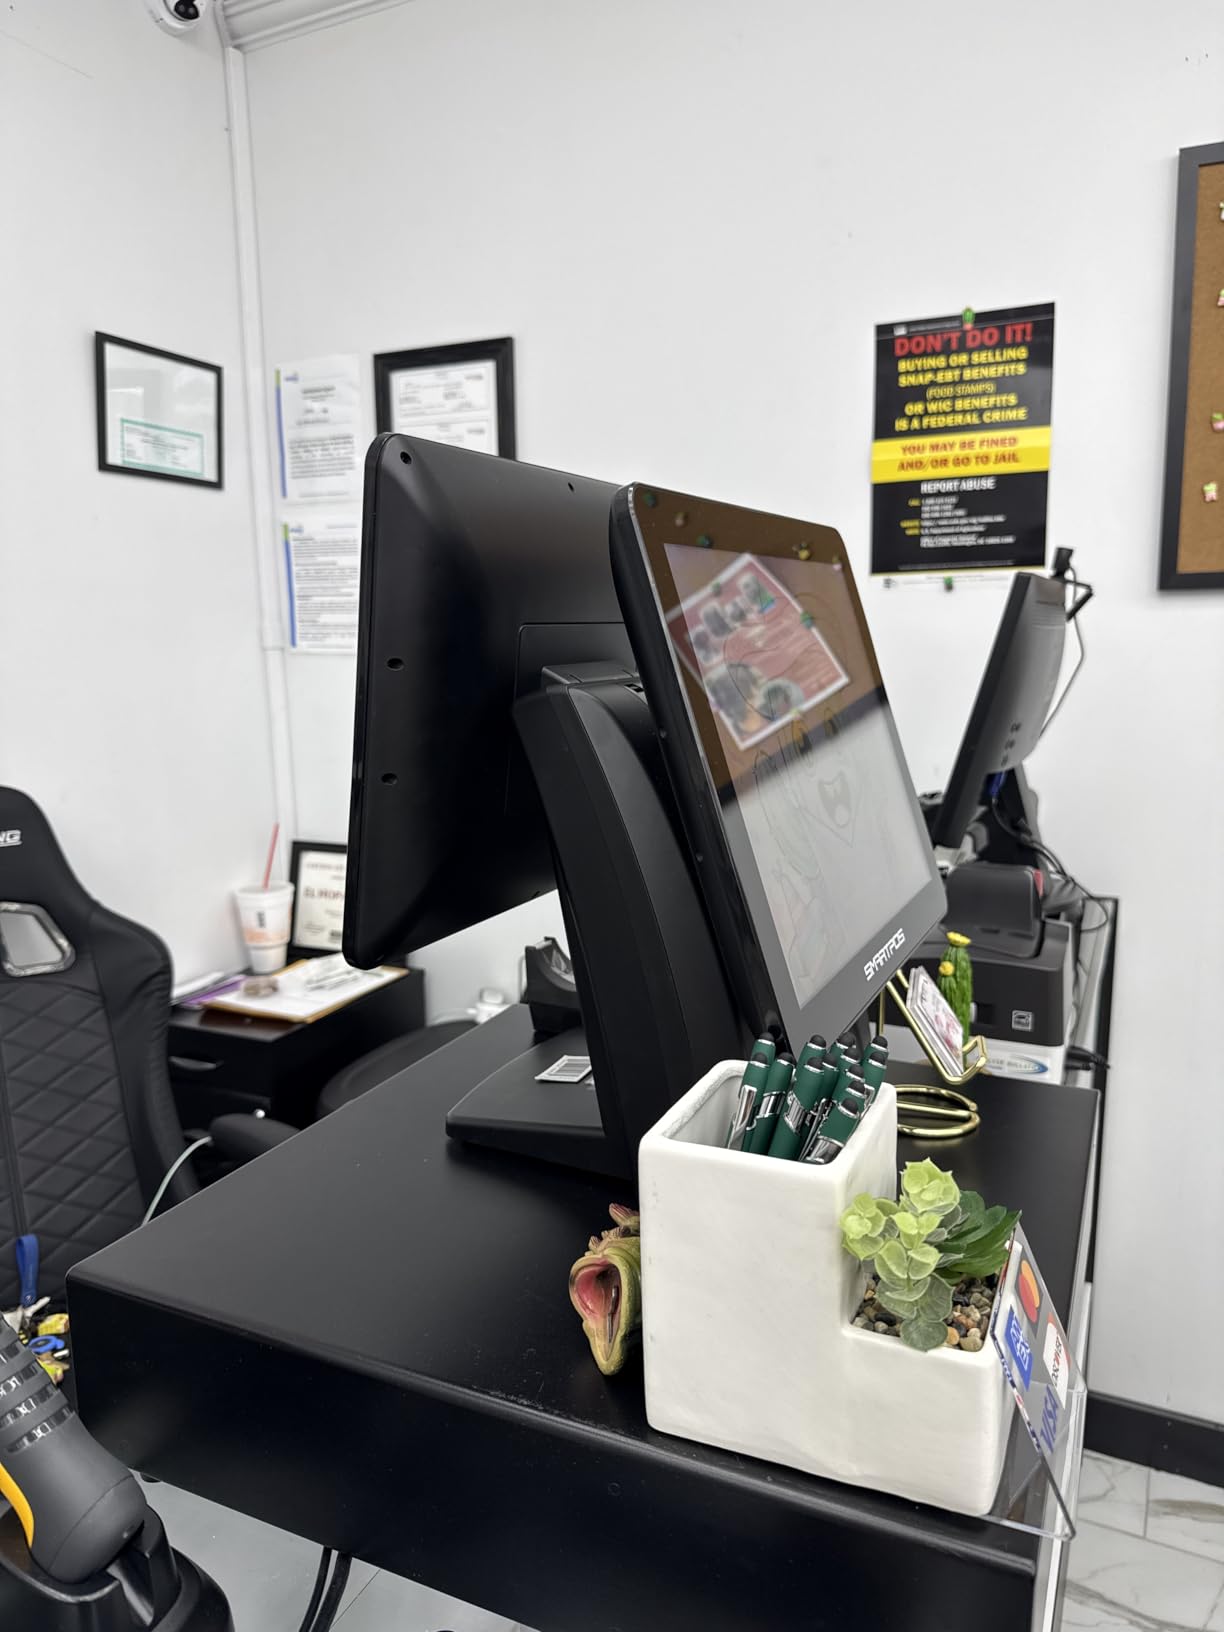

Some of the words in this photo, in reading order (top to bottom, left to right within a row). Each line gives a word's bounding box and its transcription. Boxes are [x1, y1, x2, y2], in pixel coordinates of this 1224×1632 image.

[894, 332, 961, 356] DON'T
[966, 327, 999, 348] DO
[1005, 322, 1033, 344] IT!
[898, 355, 947, 372] BUYING
[949, 352, 969, 368] OR
[971, 346, 1028, 364] SELLING
[898, 368, 961, 387] SNAP-EBT
[962, 363, 1026, 380] BENEFITS
[904, 401, 924, 416] OR
[926, 399, 952, 414] WIC
[954, 392, 1018, 411] BENEFITS
[895, 418, 909, 432] IS
[910, 418, 921, 430] A
[922, 412, 982, 429] FEDERAL
[982, 406, 1028, 424] CRIME
[900, 444, 925, 456] YOU
[929, 442, 956, 453] MAY
[960, 440, 976, 451] BE
[979, 437, 1017, 449] FINED
[897, 458, 948, 472] AND/OR
[952, 455, 970, 468] GO
[975, 454, 990, 466] TO
[992, 452, 1019, 464] JAIL
[920, 478, 959, 495] REPORT
[960, 476, 996, 492] ABUSE
[864, 928, 906, 981] SMARTPOS
[1040, 1384, 1059, 1454] VISA
